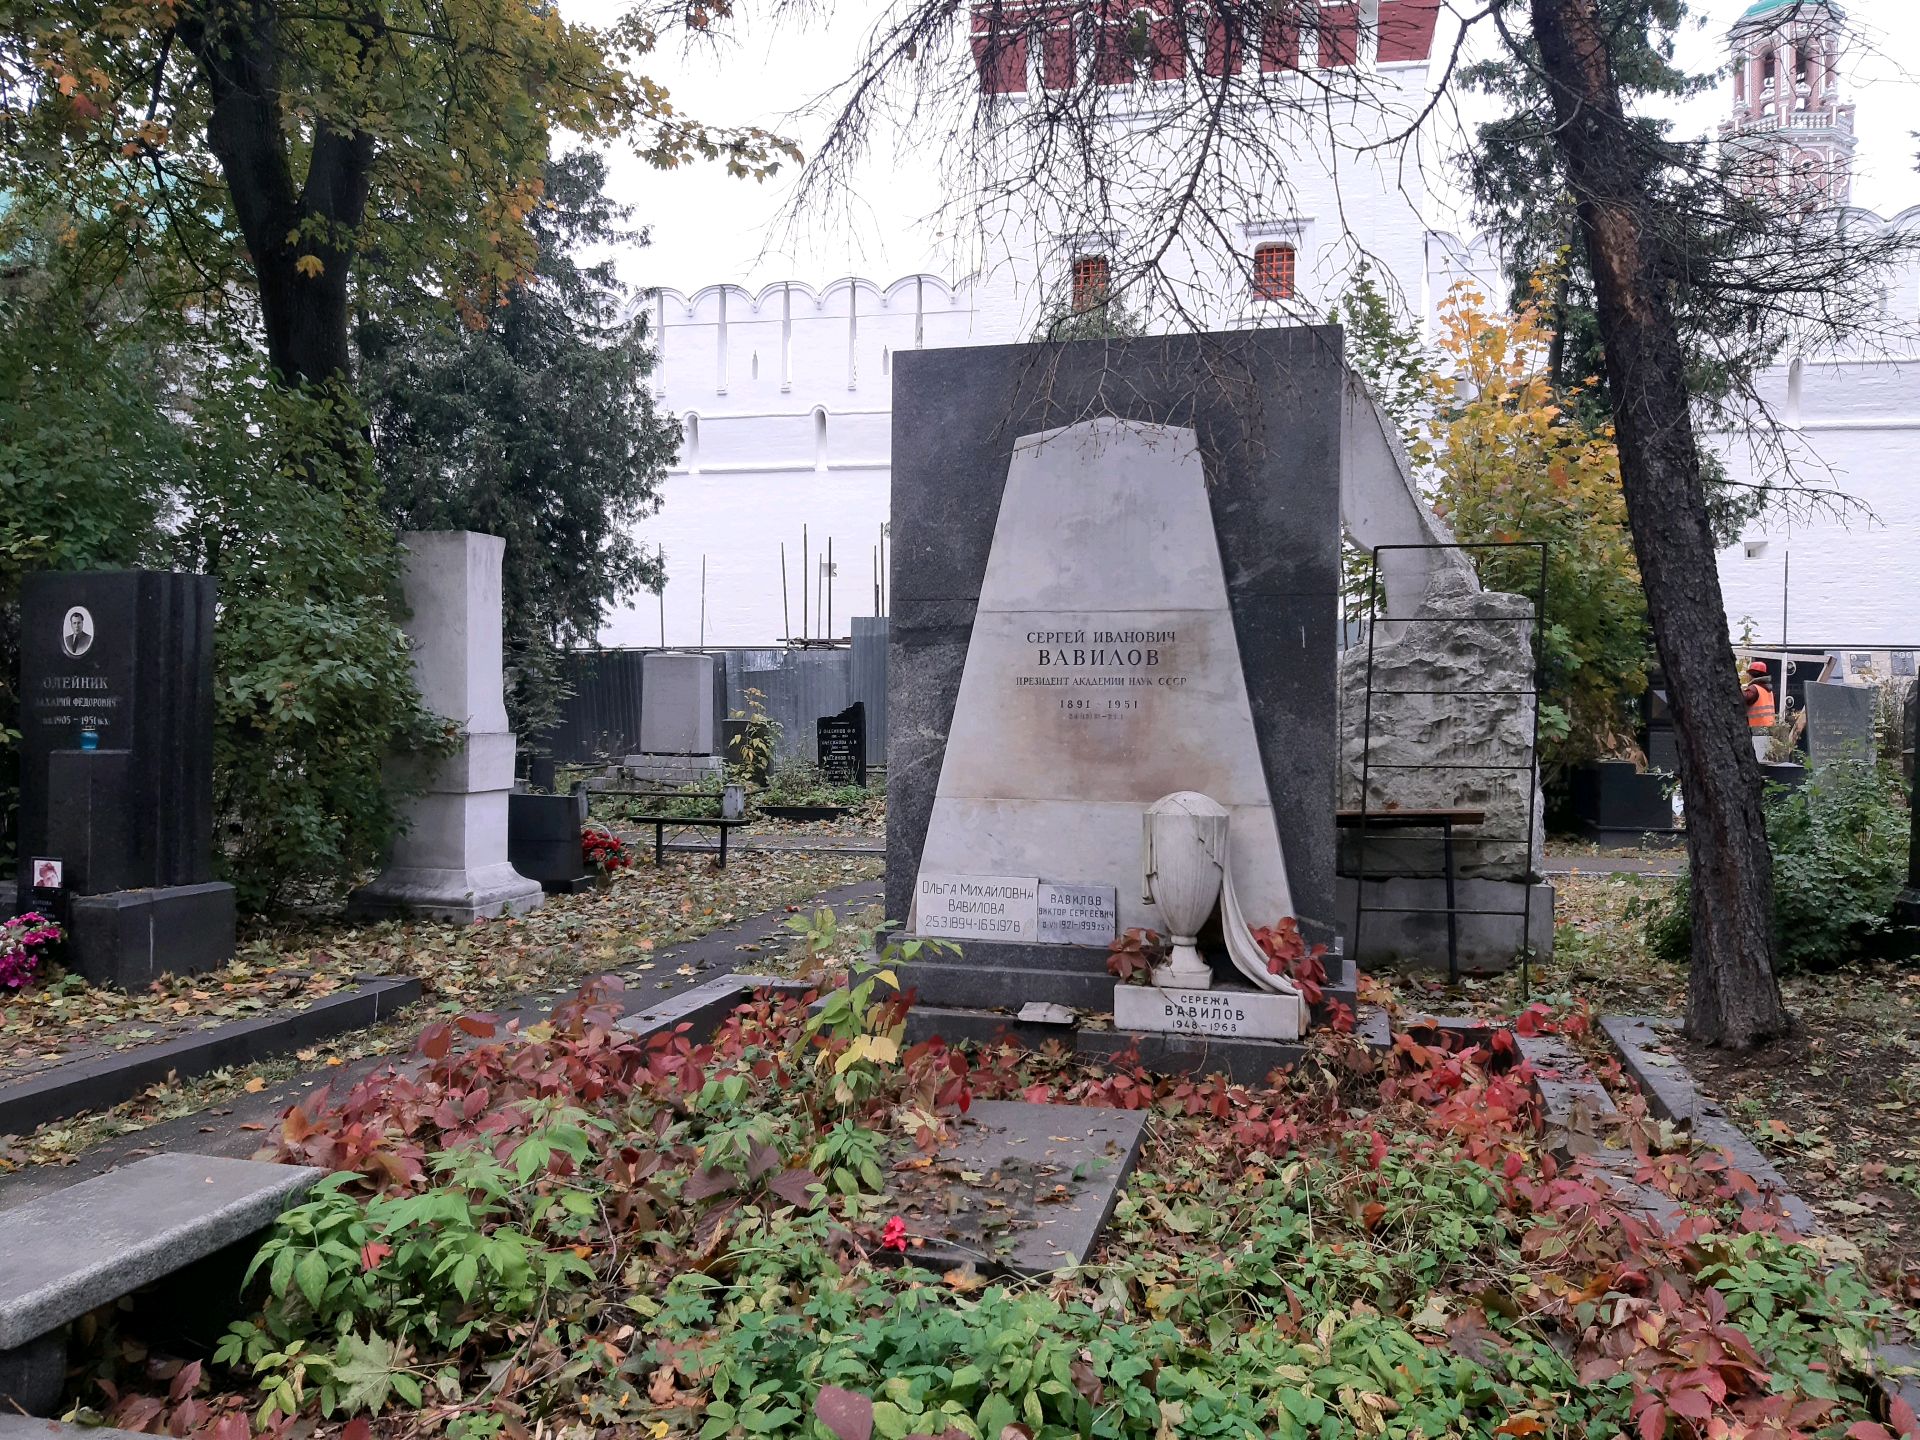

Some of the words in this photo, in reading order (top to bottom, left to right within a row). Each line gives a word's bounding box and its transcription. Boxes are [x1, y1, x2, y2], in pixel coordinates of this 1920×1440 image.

[1026, 629, 1085, 644] СЕРГЕЙ
[1093, 630, 1176, 643] ИВАНОВИЧ
[1038, 649, 1160, 666] ВАВИЛОВ
[43, 675, 109, 689] ОЛЕЙНИК
[1015, 677, 1070, 686] ПРЕЗИДЕНТ
[1072, 677, 1125, 686] АКАДЕМИИ
[1128, 677, 1153, 686] НАУК
[1158, 677, 1188, 686] СССР
[1060, 699, 1090, 709] 1891
[1107, 700, 1138, 709] 1951
[1050, 893, 1102, 906] ВАВИЛОВ
[948, 898, 1005, 915] ВАВИЛОВА
[1038, 907, 1067, 916] ВИКТОР
[1069, 908, 1114, 919] СЕРГЕЕВИЧ
[1180, 995, 1229, 1006] СЕРЕЖА
[1164, 1005, 1245, 1021] ВАВИЛОВ
